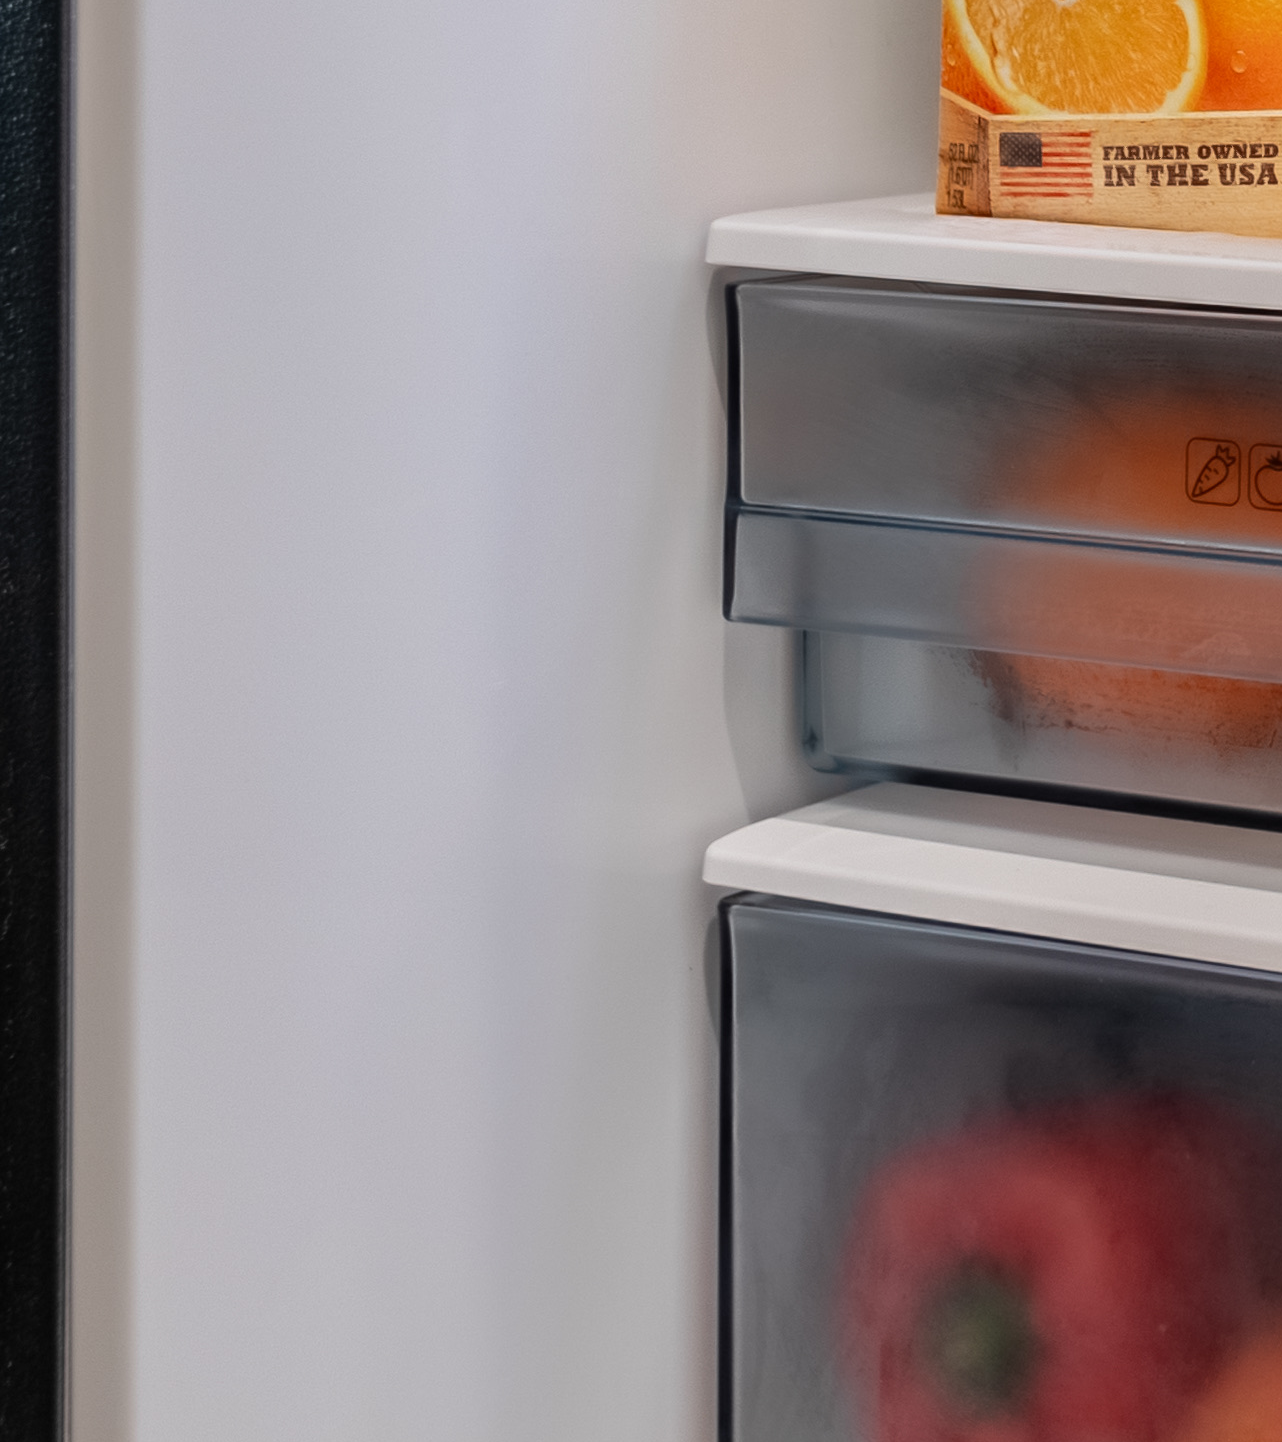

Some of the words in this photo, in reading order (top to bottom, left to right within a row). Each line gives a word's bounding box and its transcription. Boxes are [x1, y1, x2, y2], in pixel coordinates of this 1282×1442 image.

[1102, 144, 1190, 162] FARMER
[1196, 143, 1279, 160] OWNED
[1102, 164, 1137, 187] IN
[1145, 163, 1209, 187] THE
[1217, 162, 1280, 187] USA
